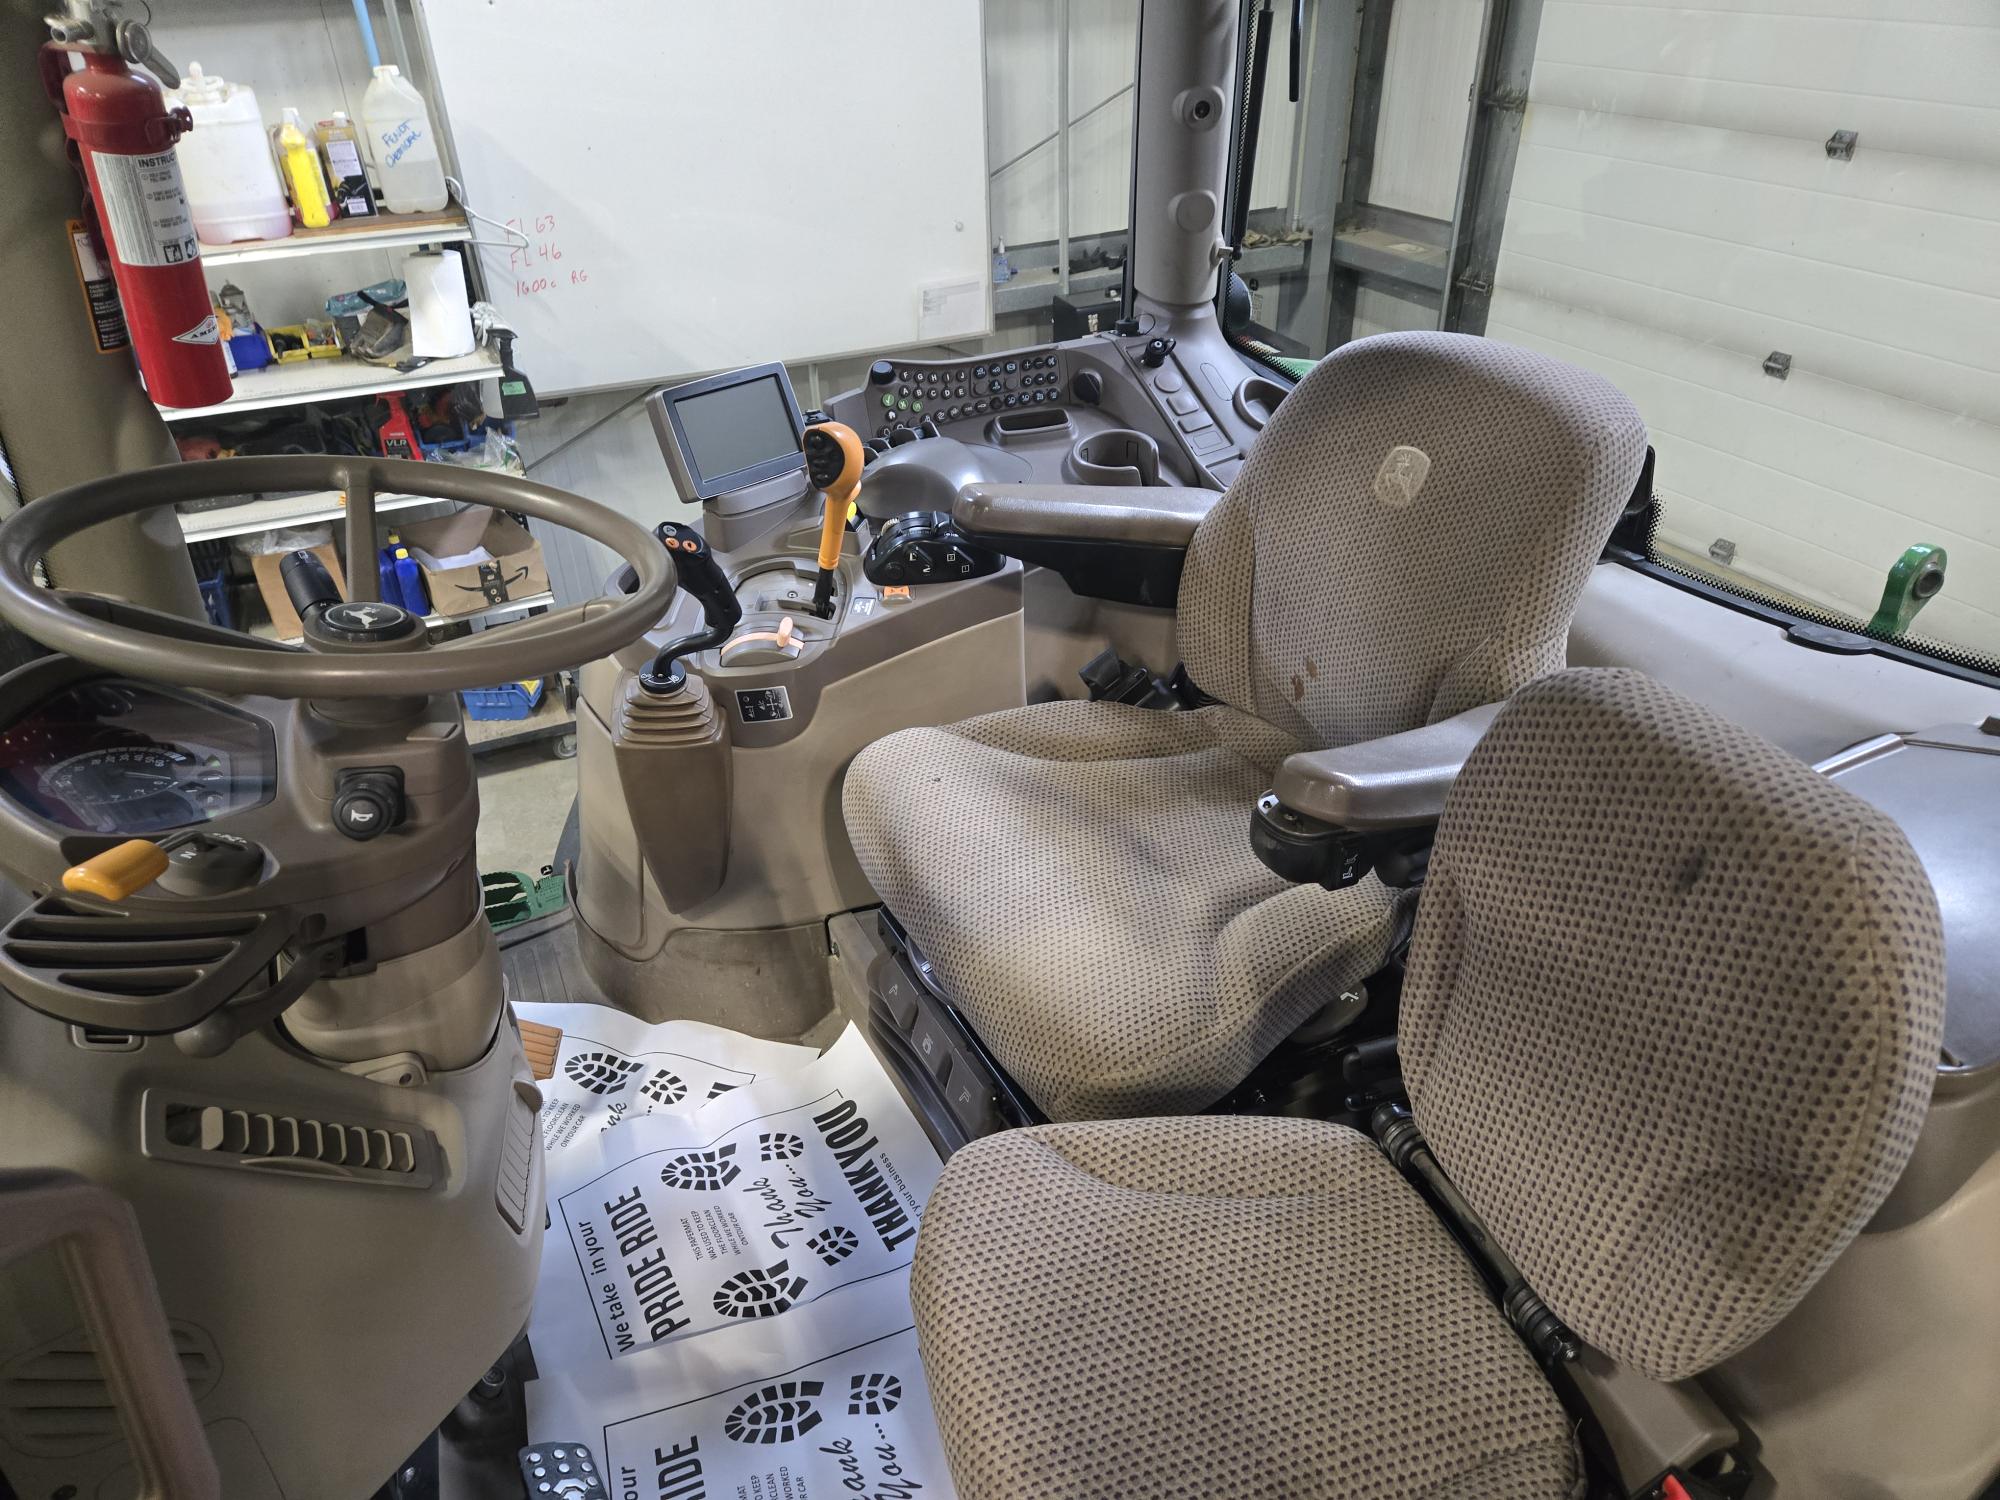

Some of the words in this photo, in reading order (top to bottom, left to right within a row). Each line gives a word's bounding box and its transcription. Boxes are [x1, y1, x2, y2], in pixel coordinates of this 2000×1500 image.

[536, 215, 555, 233] 63
[539, 242, 562, 261] 46
[880, 1152, 906, 1192] business
[743, 1177, 804, 1250] Thank
[903, 1191, 921, 1213] your
[604, 1185, 659, 1257] RIDE
[690, 1210, 701, 1224] KEEP
[697, 1223, 704, 1232] TO
[713, 1205, 729, 1229] WORKED
[578, 1221, 604, 1257] your
[701, 1231, 712, 1247] USED
[719, 1243, 728, 1255] THE
[693, 1246, 704, 1261] THIS
[706, 1246, 718, 1260] WAS
[590, 1257, 607, 1276] in
[602, 1282, 626, 1320] take
[626, 1247, 691, 1342] PRIDE
[615, 1321, 635, 1352] We
[655, 1435, 707, 1500] IDE
[819, 1437, 871, 1500] ank
[621, 1466, 639, 1500] our
[750, 1475, 761, 1494] KEEP
